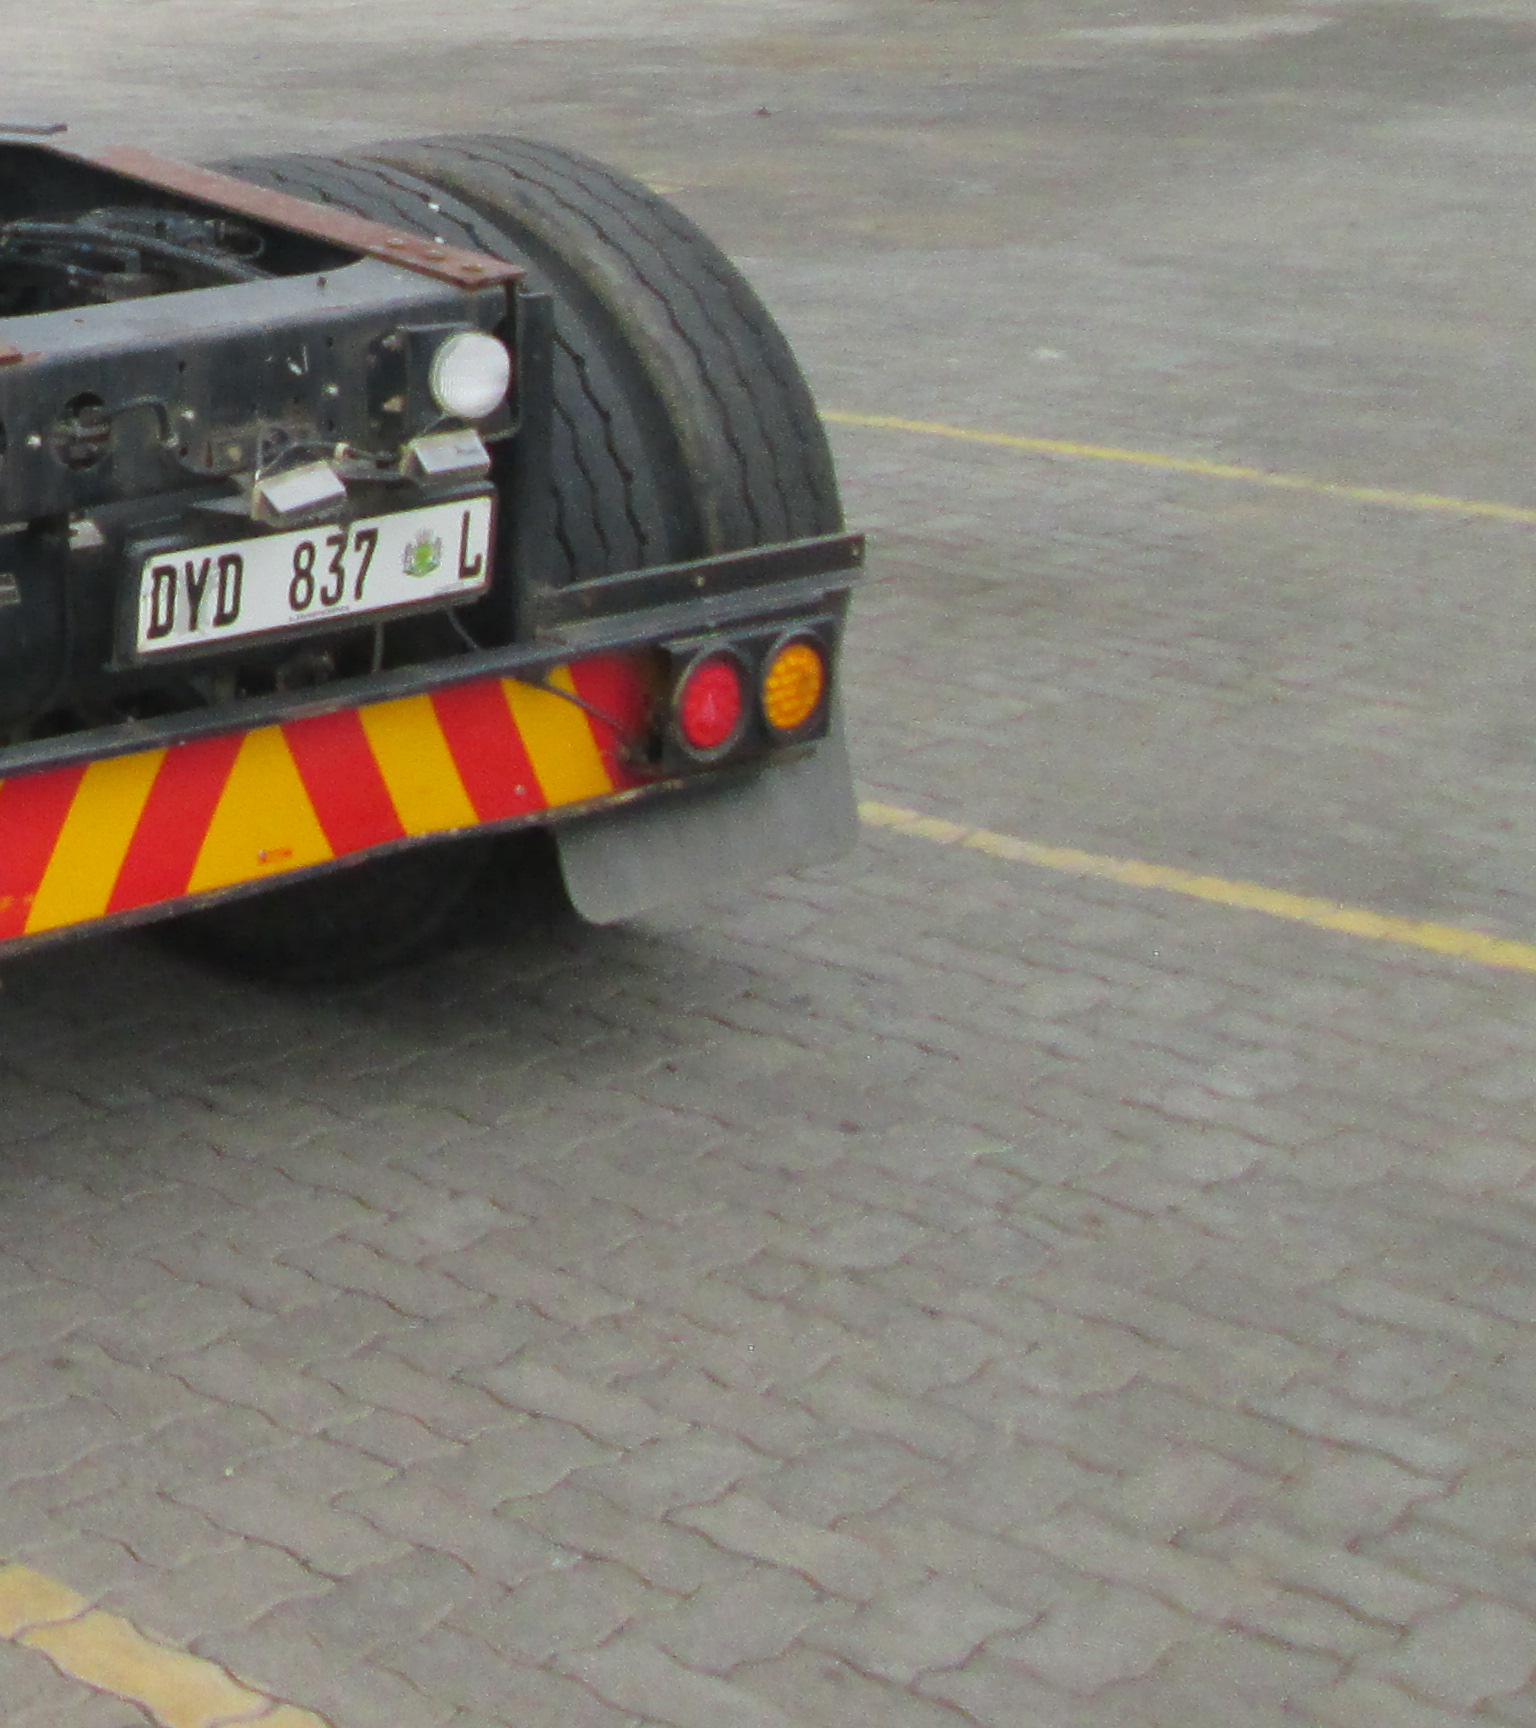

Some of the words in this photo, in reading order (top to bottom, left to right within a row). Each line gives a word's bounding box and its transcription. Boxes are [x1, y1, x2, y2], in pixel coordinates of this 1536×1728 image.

[147, 553, 243, 638] DYD
[289, 528, 379, 611] 837
[458, 511, 482, 579] L
